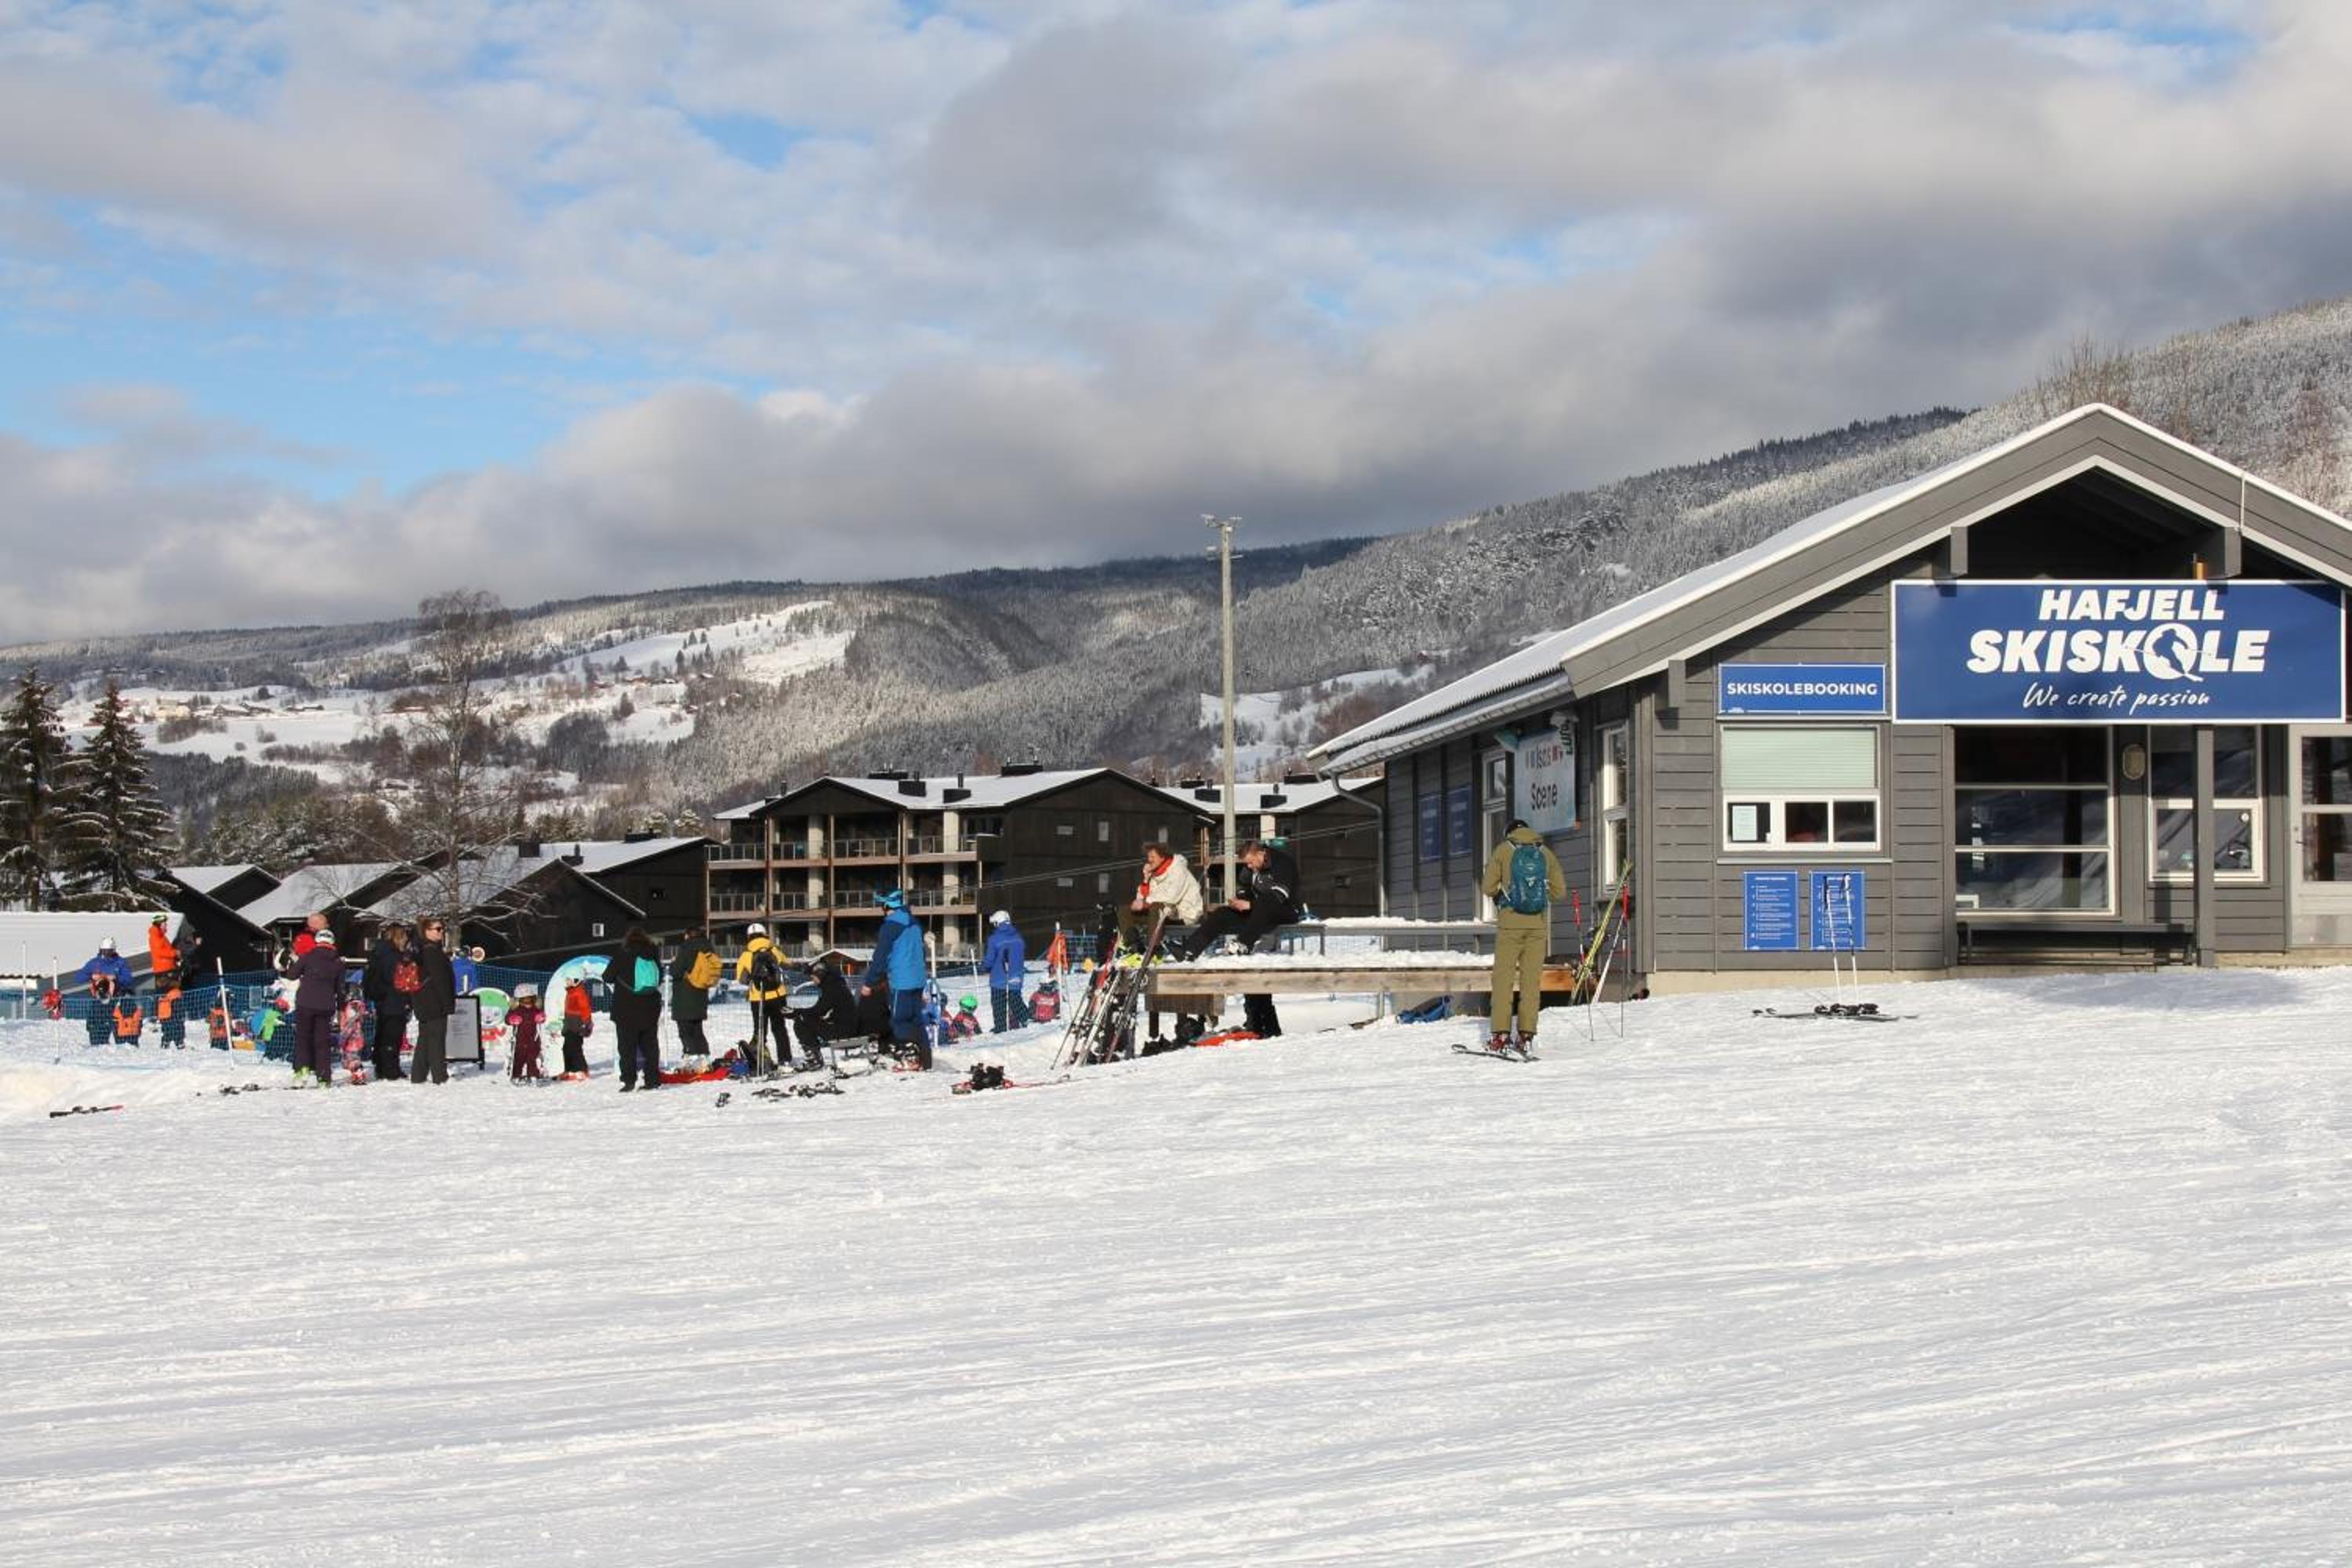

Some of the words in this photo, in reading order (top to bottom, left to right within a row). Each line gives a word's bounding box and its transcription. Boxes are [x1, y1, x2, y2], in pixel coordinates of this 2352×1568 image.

[2038, 589, 2225, 621] HAFJELL
[1726, 682, 1878, 695] SKISKOLEBOOKING
[2023, 682, 2060, 708] We
[2067, 684, 2127, 709] create
[2129, 689, 2211, 716] passion
